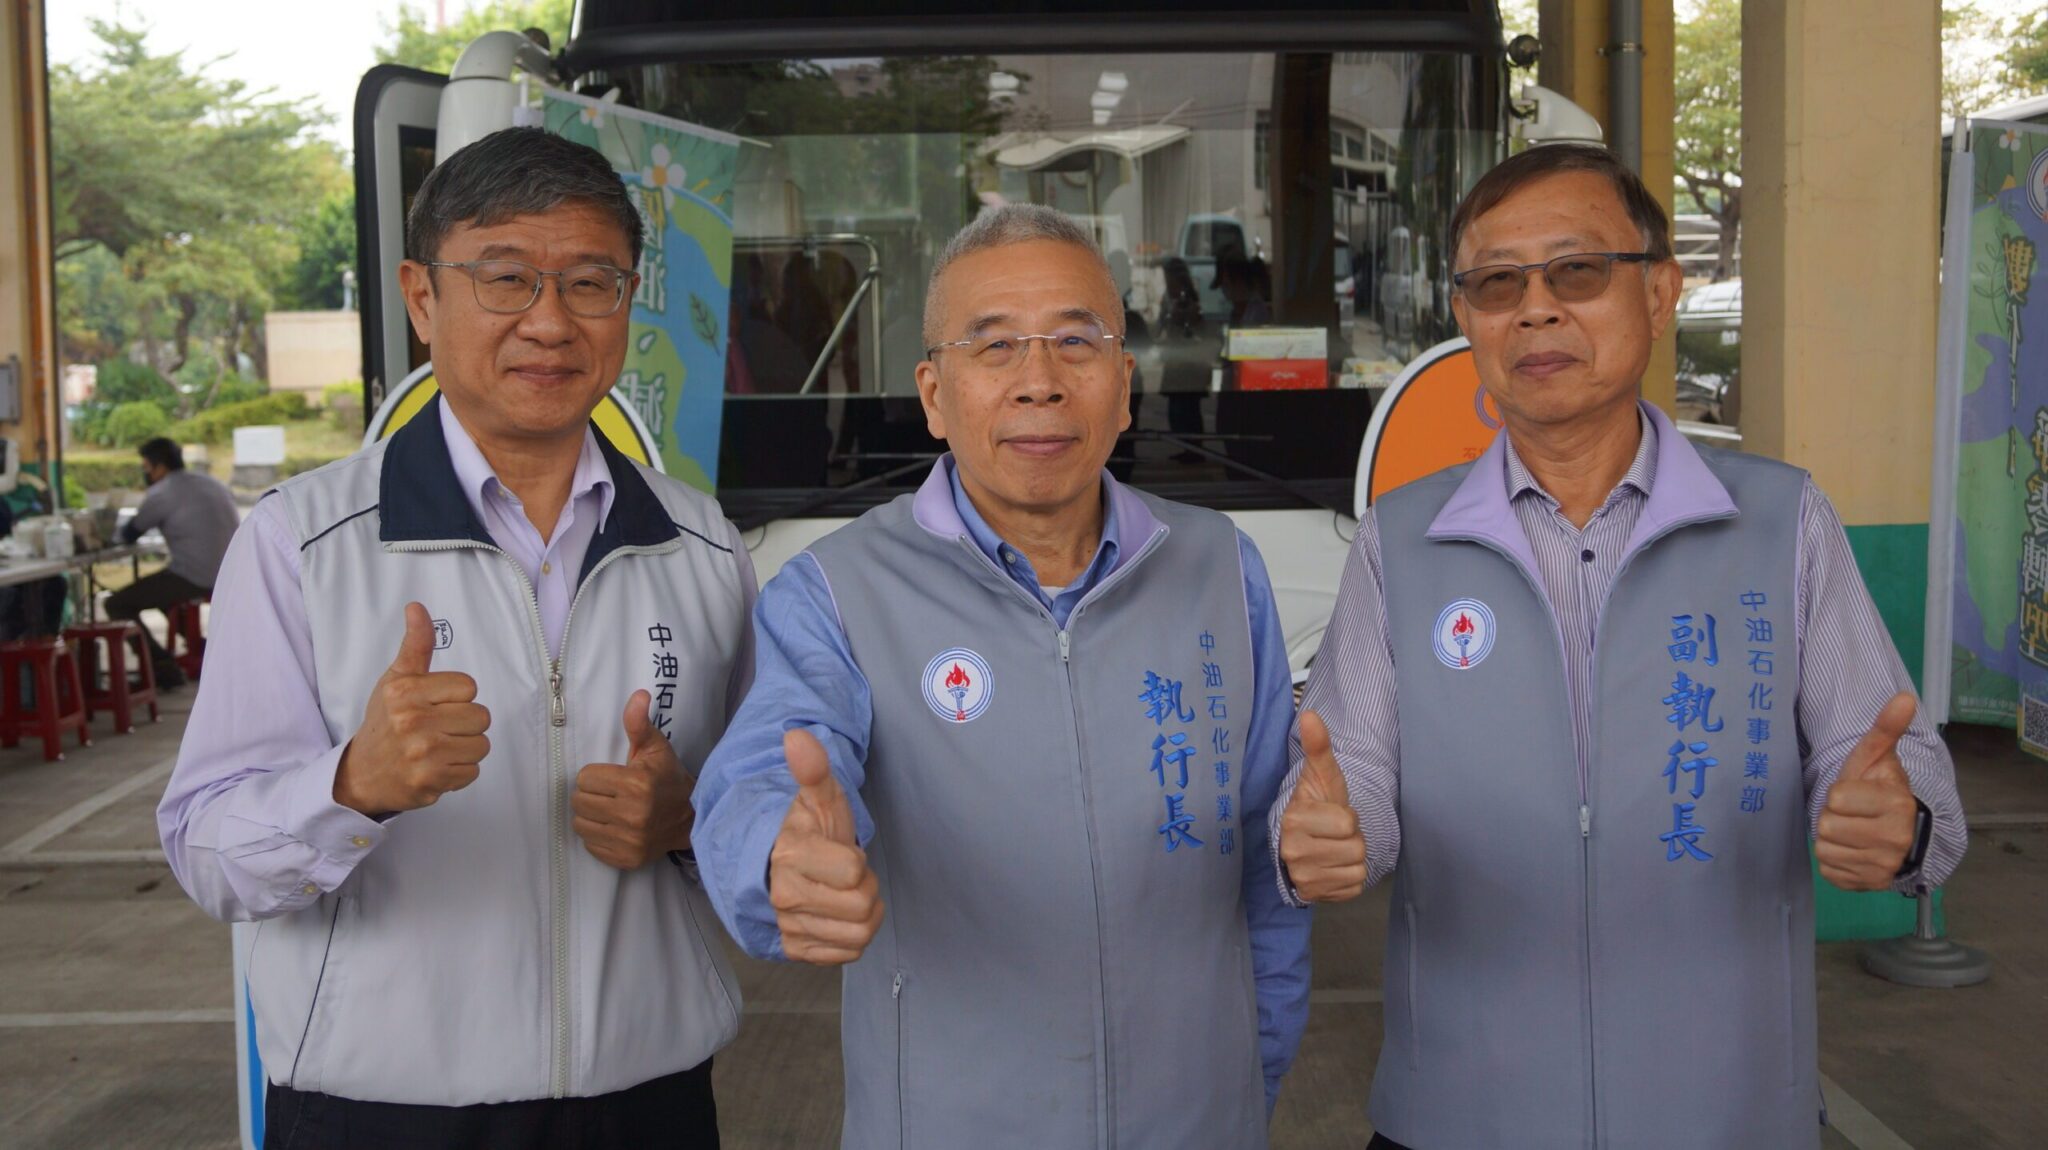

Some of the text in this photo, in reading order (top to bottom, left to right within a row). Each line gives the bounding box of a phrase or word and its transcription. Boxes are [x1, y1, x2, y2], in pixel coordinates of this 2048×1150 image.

[1138, 670, 1205, 852] 執行長
[1199, 630, 1234, 856] 中油石化事業部
[1659, 613, 1724, 862] 副執行長
[1739, 590, 1773, 813] 中油石化事業部
